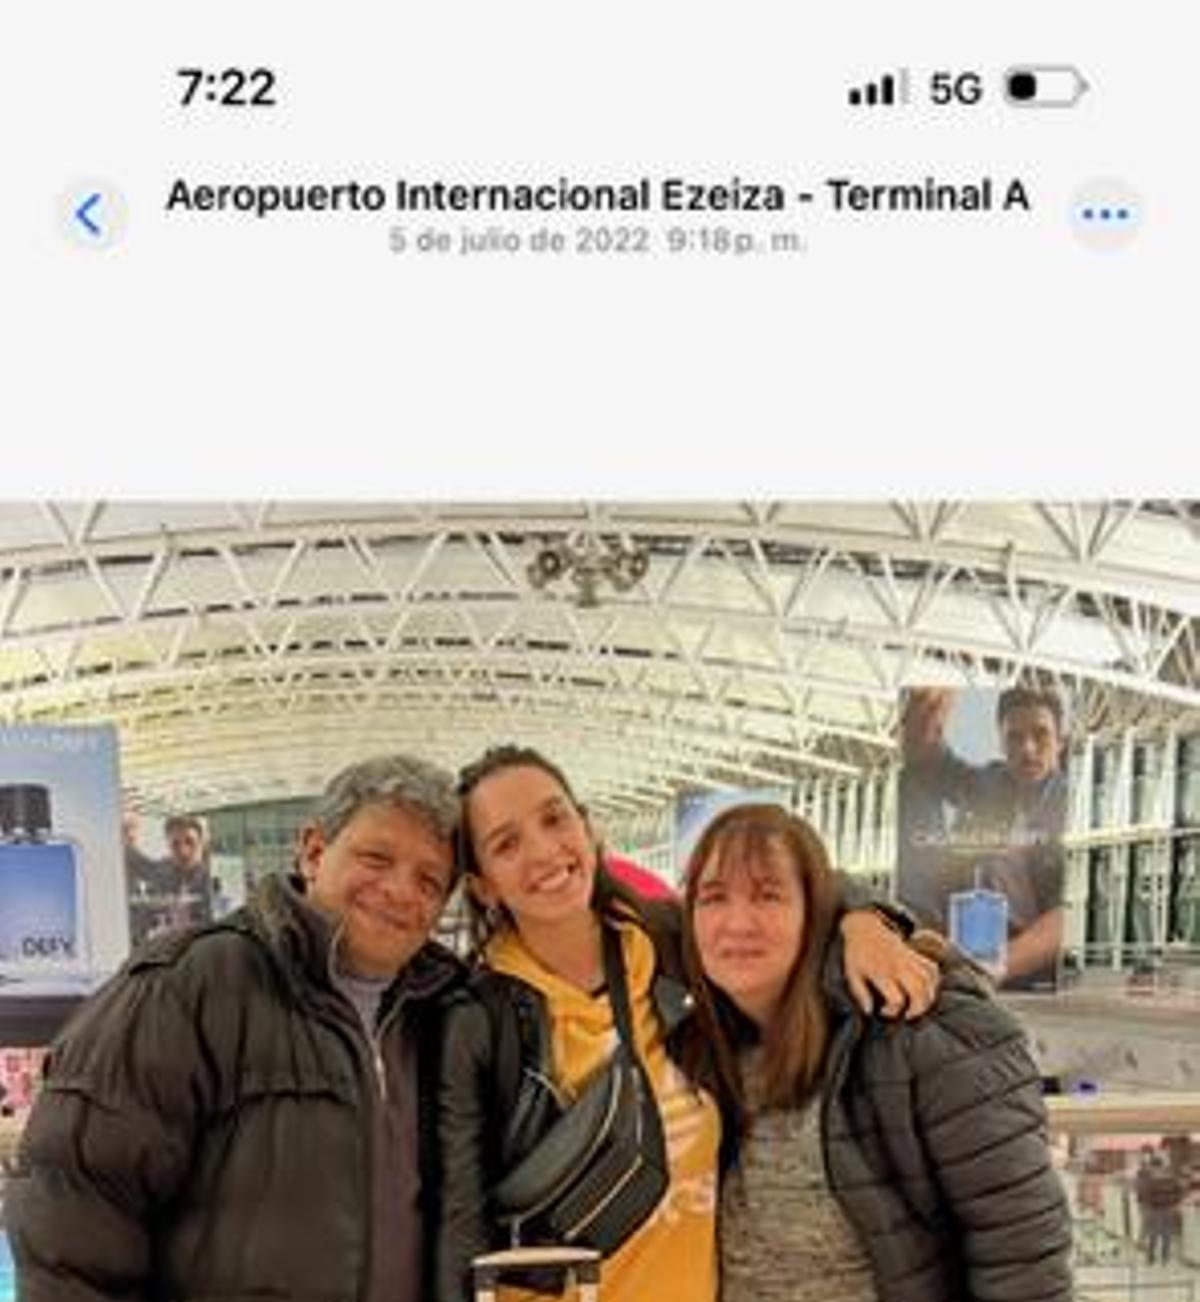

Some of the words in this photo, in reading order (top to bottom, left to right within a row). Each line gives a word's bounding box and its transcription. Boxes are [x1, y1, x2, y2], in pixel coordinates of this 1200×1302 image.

[177, 68, 276, 106] 7:22
[930, 72, 983, 106] 5G
[165, 178, 386, 218] Aeropuerto
[397, 177, 650, 211] Internacional
[662, 177, 785, 211] Ezeiza
[825, 177, 992, 211] Terminal
[1002, 178, 1030, 211] A
[389, 229, 408, 254] 5
[416, 227, 451, 253] de
[459, 227, 522, 258] julio
[530, 227, 565, 253] de
[576, 228, 650, 254] 2022
